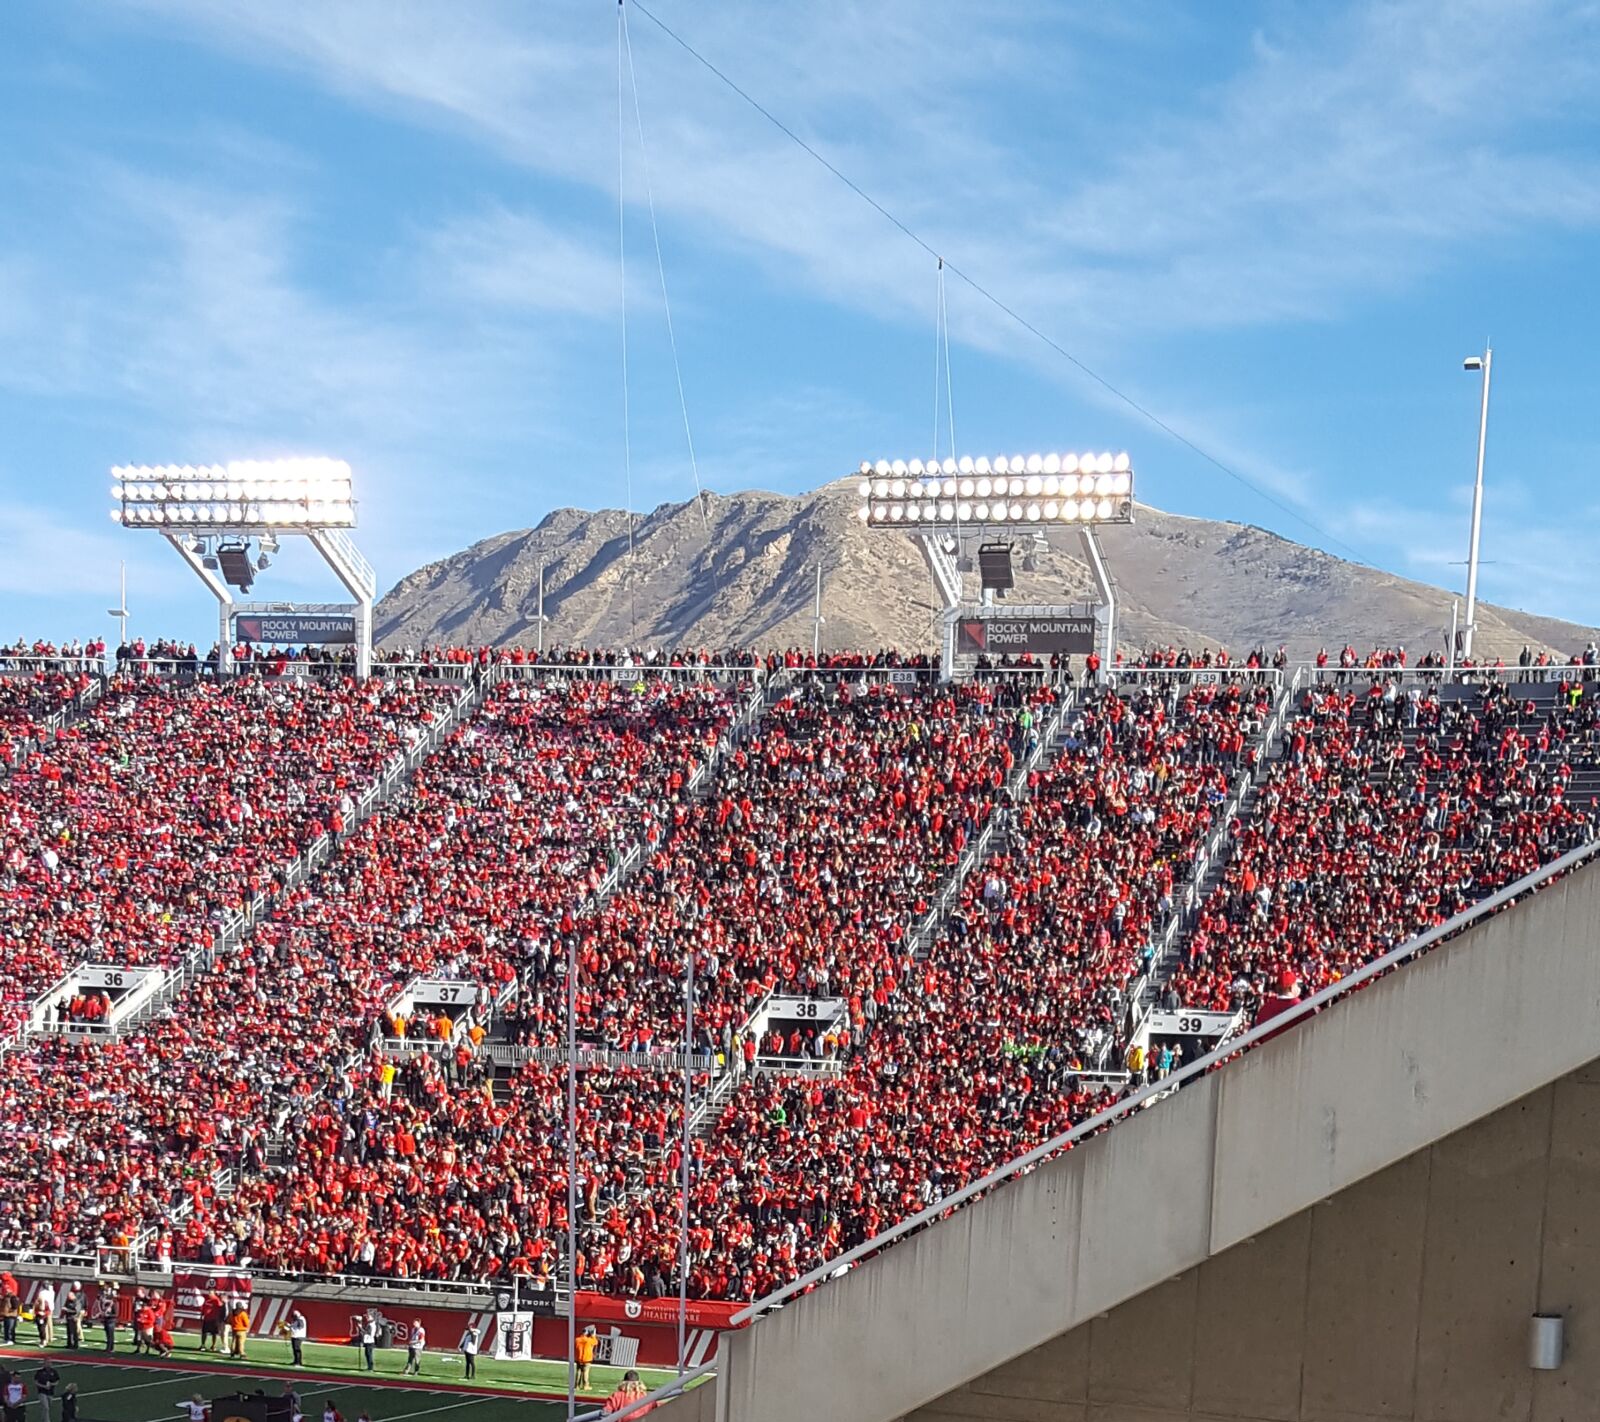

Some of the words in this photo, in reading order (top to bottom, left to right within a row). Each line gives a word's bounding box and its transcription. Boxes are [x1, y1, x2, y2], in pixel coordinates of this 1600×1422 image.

[261, 620, 296, 630] ROCKY
[299, 621, 353, 632] MOUNTAIN
[987, 623, 1027, 634] ROCKY
[1029, 623, 1092, 634] MOUNTAIN
[261, 630, 299, 640] POWER
[986, 633, 1029, 644] POWER
[617, 670, 636, 679] E37
[892, 672, 912, 682] E38
[1196, 673, 1216, 683] E39
[1550, 670, 1572, 681] E40
[104, 972, 123, 986] 36
[439, 987, 460, 1002] 37
[796, 1003, 818, 1018] 38
[1178, 1017, 1202, 1033] 39
[643, 1310, 675, 1321] HEALTH
